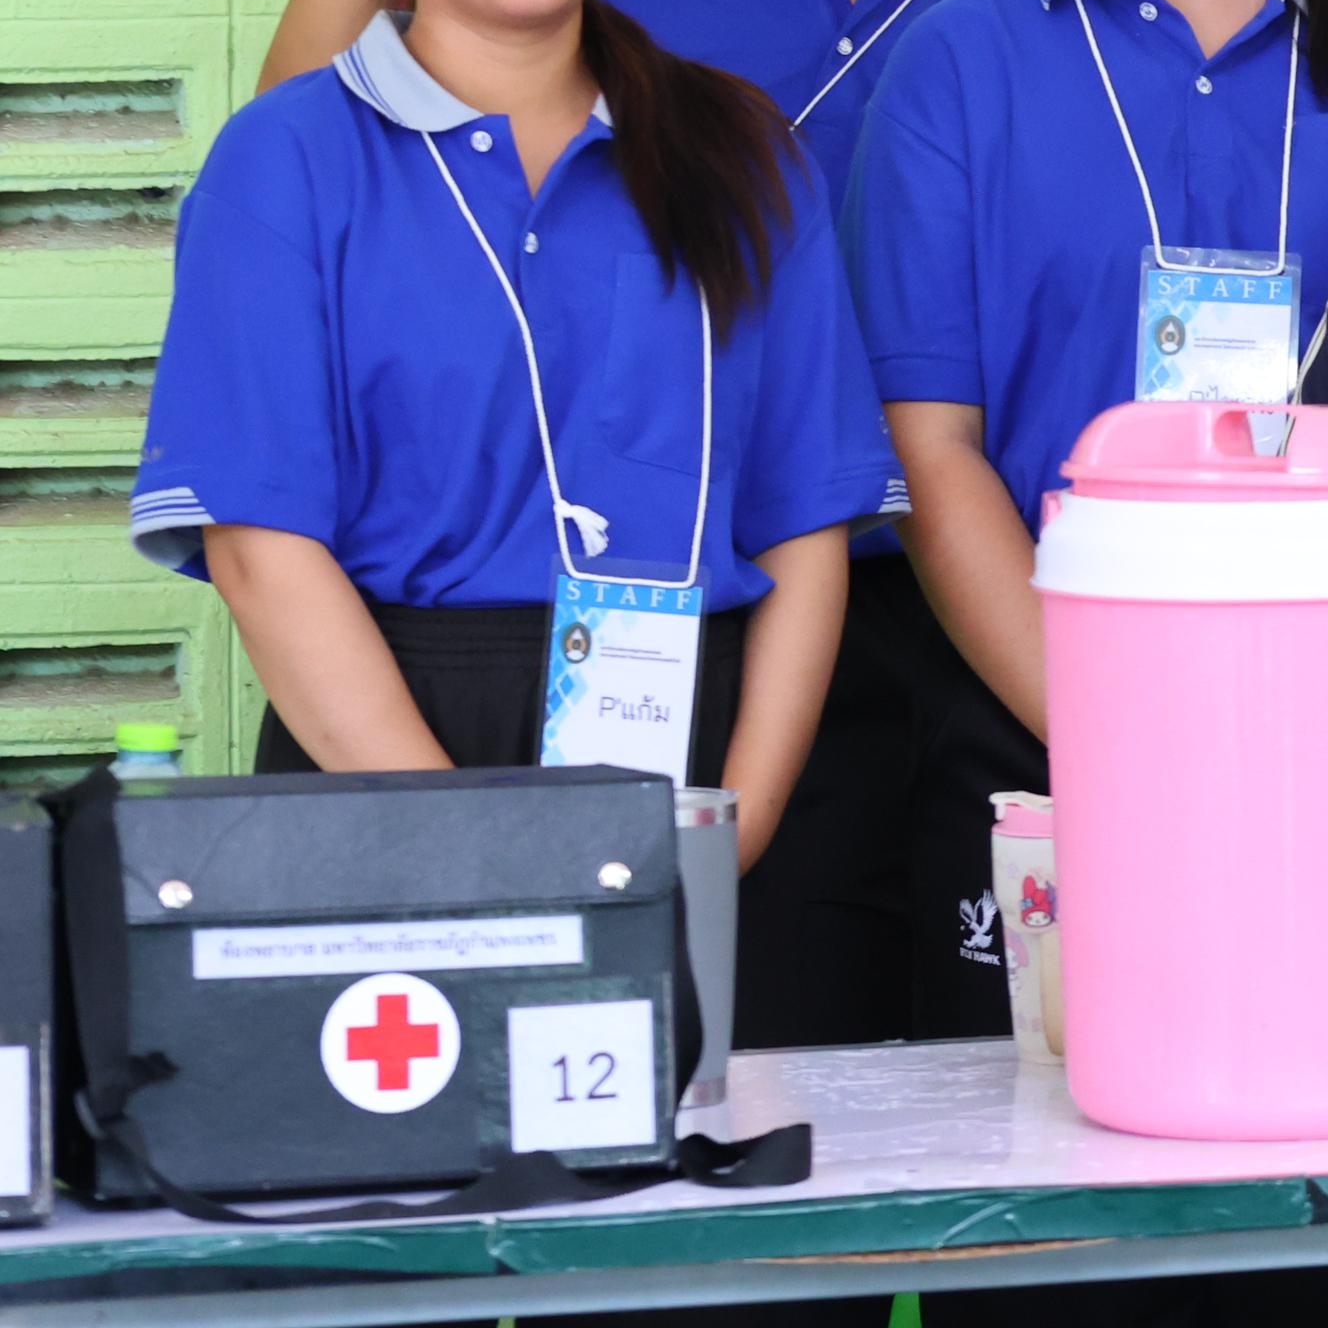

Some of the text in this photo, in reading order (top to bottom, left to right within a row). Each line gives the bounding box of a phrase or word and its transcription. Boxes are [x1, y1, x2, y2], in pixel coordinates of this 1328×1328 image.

[1158, 275, 1282, 300] STAFF
[565, 580, 693, 610] STAFF
[552, 1051, 618, 1102] 12
